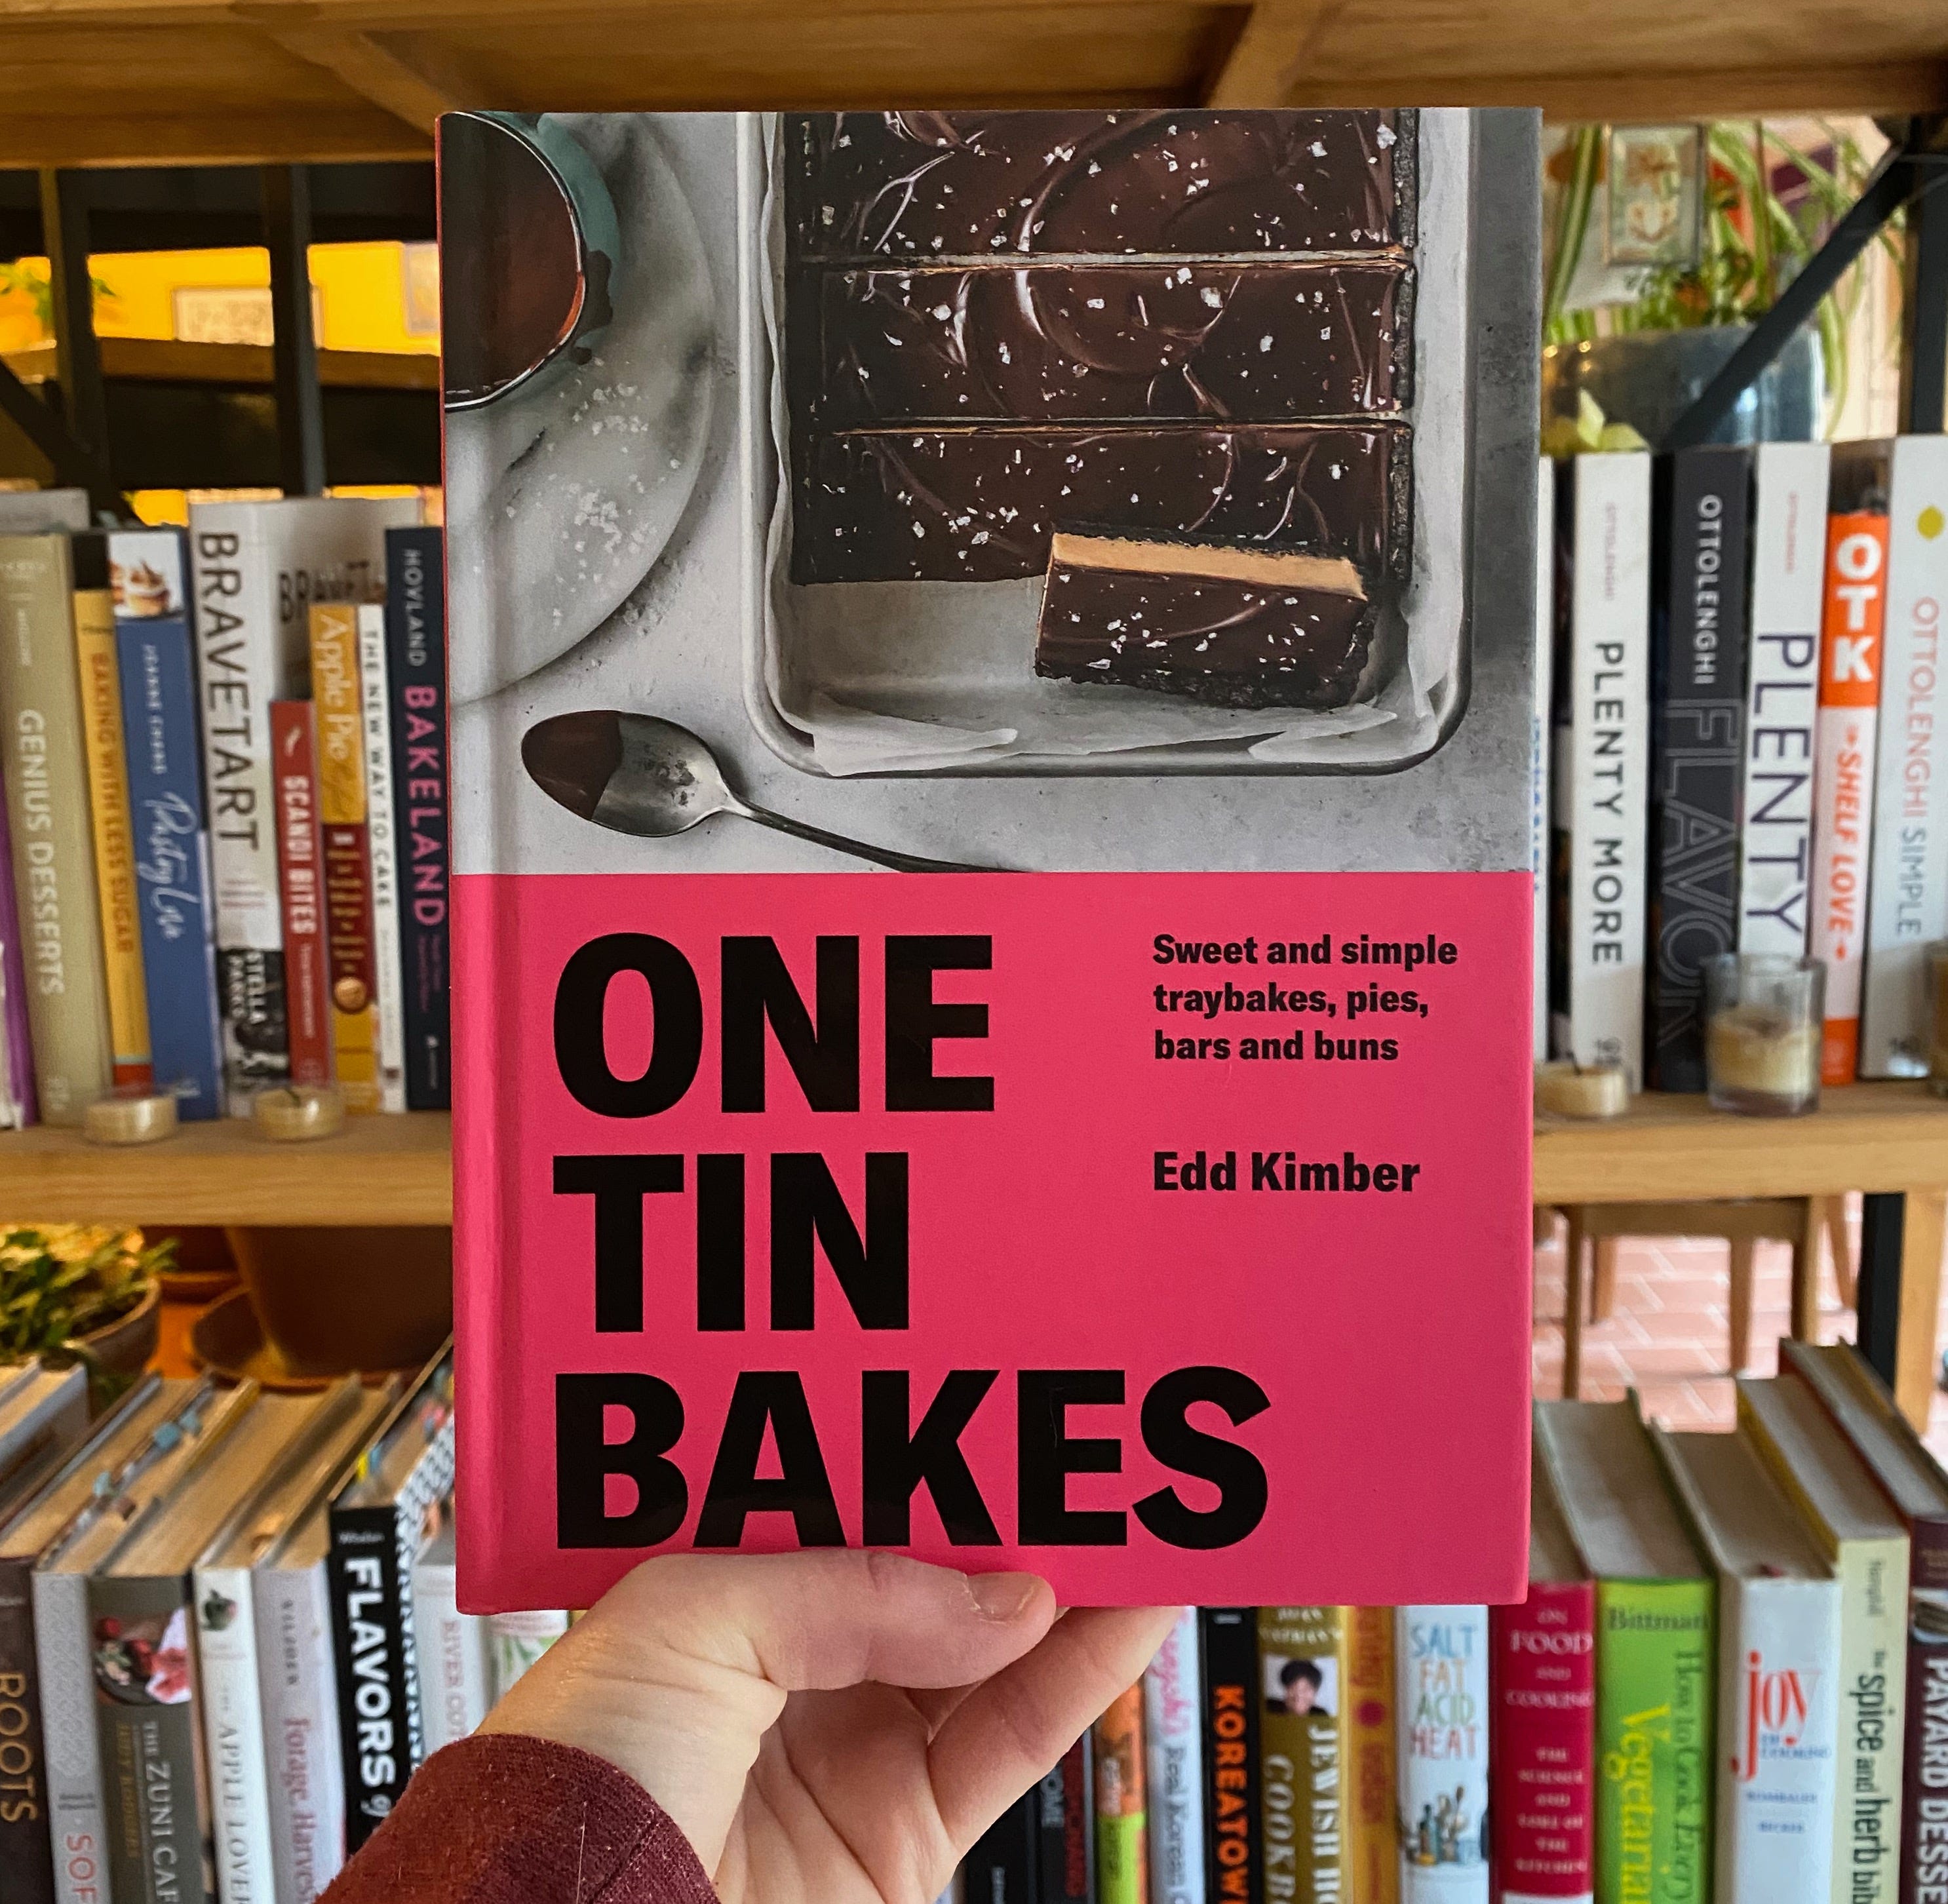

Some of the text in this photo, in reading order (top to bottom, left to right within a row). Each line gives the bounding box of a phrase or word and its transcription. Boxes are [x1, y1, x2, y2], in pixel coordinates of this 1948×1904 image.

[1693, 494, 1723, 685] OTTOLENGHI
[1833, 533, 1882, 683] OTK
[199, 532, 260, 849] BRAVETART
[316, 614, 360, 761] Apple Pie
[1593, 641, 1625, 817] PLENTY
[18, 709, 52, 833] GENIUS
[283, 775, 313, 861] SCANDI
[404, 685, 446, 926] BAKELAND
[1746, 632, 1816, 933] PLENTY
[1896, 596, 1941, 936] OTTOLENGHI SIMPLE
[287, 868, 317, 934] BITES
[1592, 838, 1624, 964] MORE
[1827, 752, 1863, 936] SHELF LOVE
[28, 841, 66, 996] DESSERTS
[1153, 934, 1458, 972] Sweet and simple
[553, 932, 995, 1119] ONE
[1153, 981, 1429, 1020] traybakes, pies,
[1155, 1029, 1399, 1060] bars and buns
[1154, 1150, 1421, 1192] Edd Kimber
[553, 1152, 910, 1334] TIN
[555, 1365, 1272, 1550] BAKES
[344, 1557, 397, 1788] FLAVORS
[1410, 1623, 1477, 1659] SALT
[1419, 1659, 1468, 1690] FAT
[1510, 1629, 1593, 1656] FOOD
[1608, 1606, 1709, 1631] Bittman
[0, 1671, 38, 1823] ROOTS
[1410, 1726, 1477, 1760] HEAT
[1414, 1694, 1476, 1726] ACID
[1729, 1649, 1813, 1783] joy
[1848, 1673, 1896, 1752] spice
[1856, 1758, 1883, 1793] and
[1921, 1657, 1948, 1789] PAYARD
[146, 1761, 173, 1837] ZUNI
[1213, 1684, 1249, 1904] KOREATOW
[1264, 1755, 1296, 1904] COOKB
[1308, 1724, 1340, 1855] JEWISH
[1603, 1702, 1672, 1904] Vegetaria
[1853, 1796, 1893, 1865] herb
